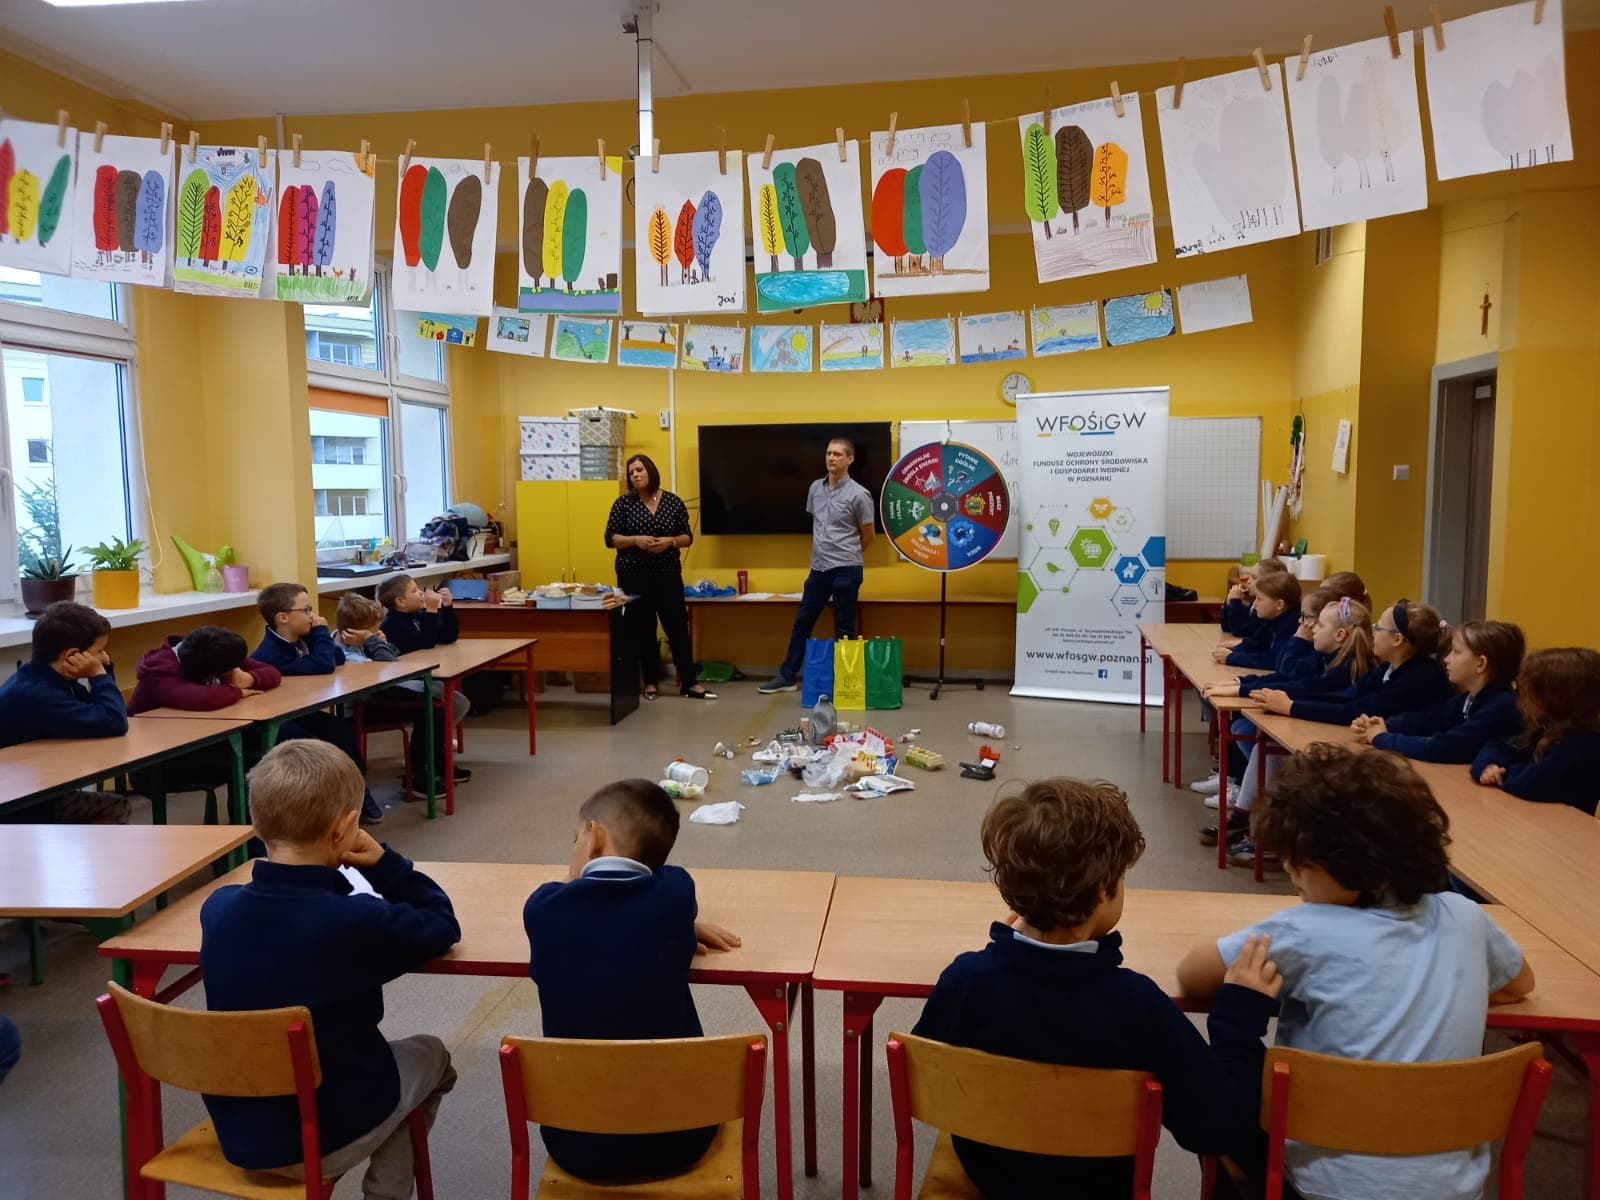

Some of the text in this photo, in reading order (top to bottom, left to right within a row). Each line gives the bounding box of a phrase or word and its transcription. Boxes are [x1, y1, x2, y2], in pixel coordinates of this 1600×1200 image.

[1036, 410, 1146, 432] WFOŚiGW
[958, 451, 979, 464] PYTANIE
[1066, 450, 1113, 458] WOJEWÓDZKI
[954, 457, 977, 471] OGÓLNE
[1033, 457, 1148, 468] FUNDUSZ OCHRONY ŚRODOWISKA
[1054, 467, 1099, 475] GOSPODARKI
[1026, 650, 1153, 664] www.wfosgw.poznanl
